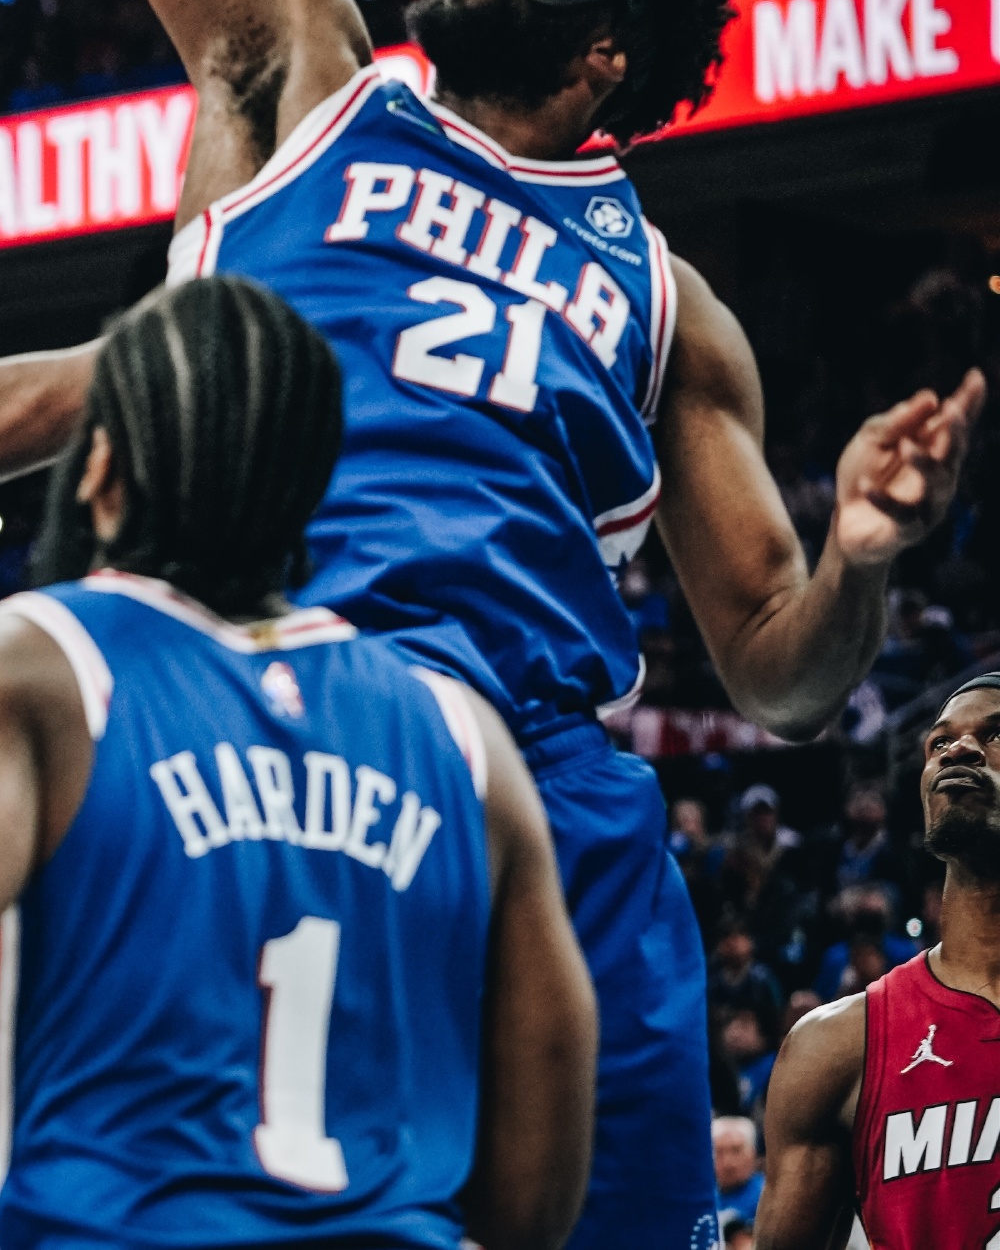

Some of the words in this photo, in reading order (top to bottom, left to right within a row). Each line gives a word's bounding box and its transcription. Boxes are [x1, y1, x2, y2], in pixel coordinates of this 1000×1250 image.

[324, 162, 631, 371] PHILA
[562, 216, 642, 266] crypto.com
[392, 275, 546, 413] 21
[150, 741, 442, 892] HARDEN
[253, 914, 350, 1195] 1
